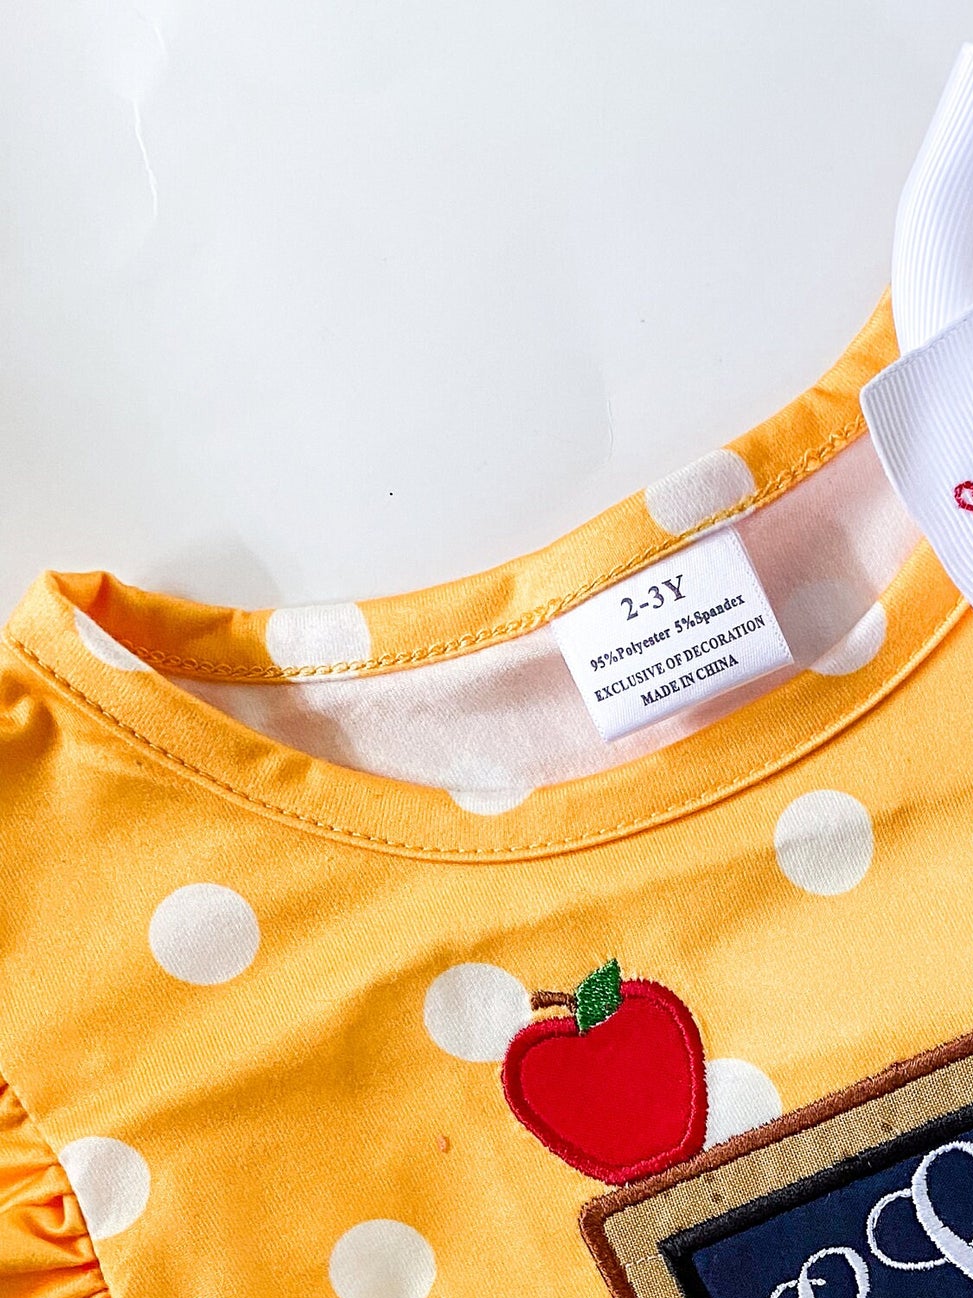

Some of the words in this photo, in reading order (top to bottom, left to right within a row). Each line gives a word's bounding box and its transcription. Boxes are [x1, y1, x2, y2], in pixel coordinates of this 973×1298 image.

[620, 574, 686, 621] 2-3Y
[594, 662, 666, 703] EXCLUSIVE
[665, 653, 684, 671] OF
[685, 614, 767, 662] DECORATION
[640, 674, 682, 707] MADE
[681, 669, 697, 688] IN
[696, 653, 740, 682] CHINA
